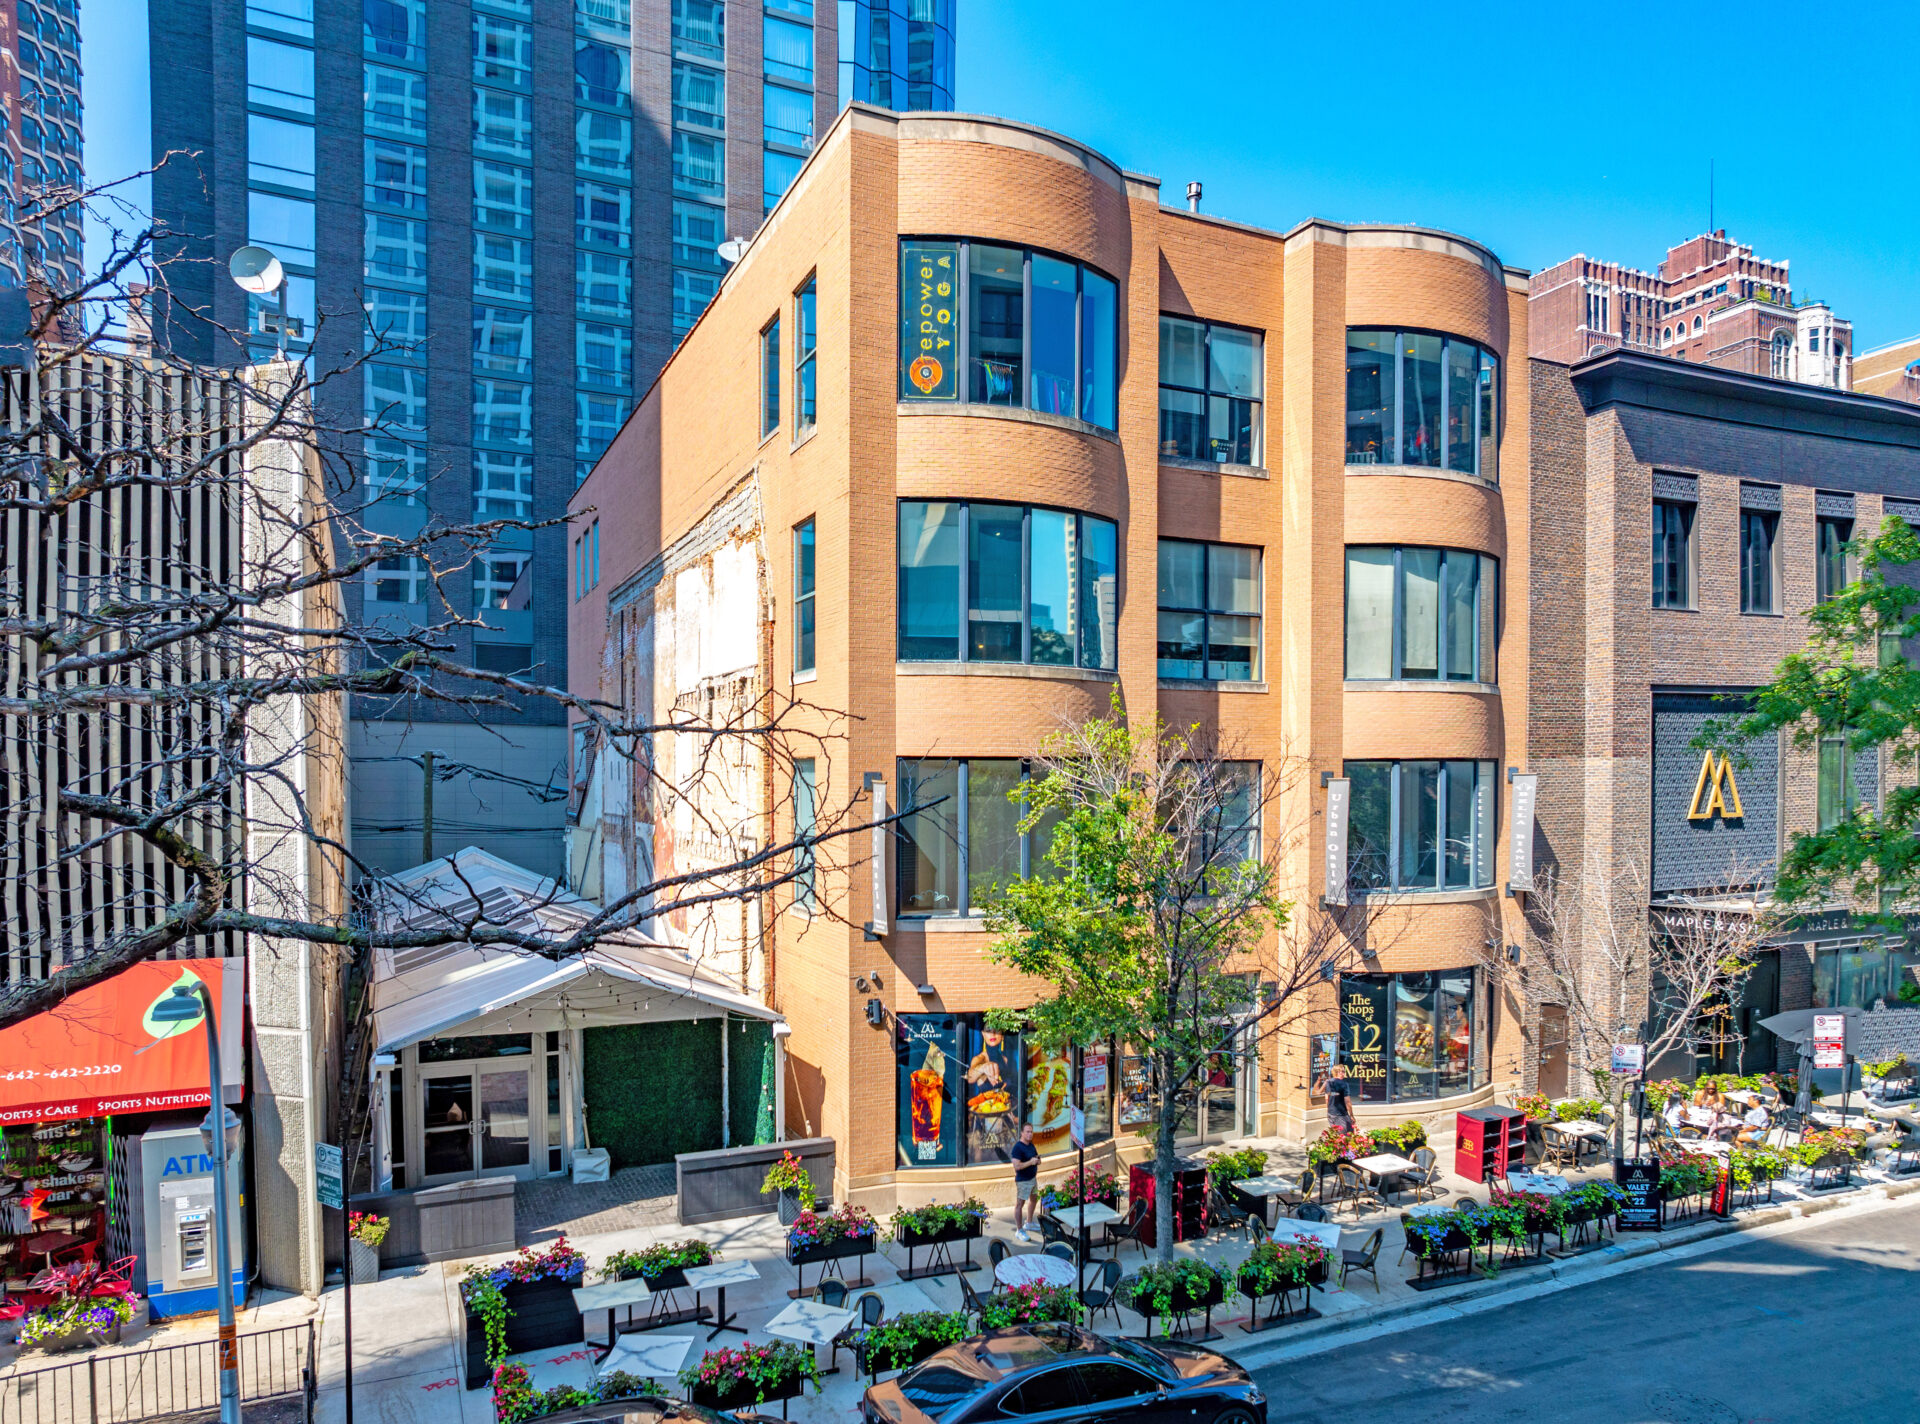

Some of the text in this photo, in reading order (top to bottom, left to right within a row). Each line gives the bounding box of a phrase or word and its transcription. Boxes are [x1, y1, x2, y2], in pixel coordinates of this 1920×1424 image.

[937, 255, 951, 350] YOGA
[1329, 793, 1342, 837] Urban
[1515, 791, 1529, 825] BELLA
[1513, 833, 1526, 875] BIANCA
[1664, 915, 1712, 930] MAPLE
[1715, 920, 1725, 931] &
[1806, 918, 1848, 932] MAPLE &
[1349, 993, 1371, 1005] The
[1342, 1003, 1374, 1017] Shops
[1365, 1013, 1374, 1022] of
[1350, 1023, 1382, 1052] 12
[1351, 1053, 1380, 1063] west
[1344, 1064, 1386, 1082] Maple
[0, 1110, 33, 1121] ORTS
[44, 1105, 78, 1116] CARE
[97, 1099, 142, 1111] SPORTS
[163, 1153, 214, 1176] ATM
